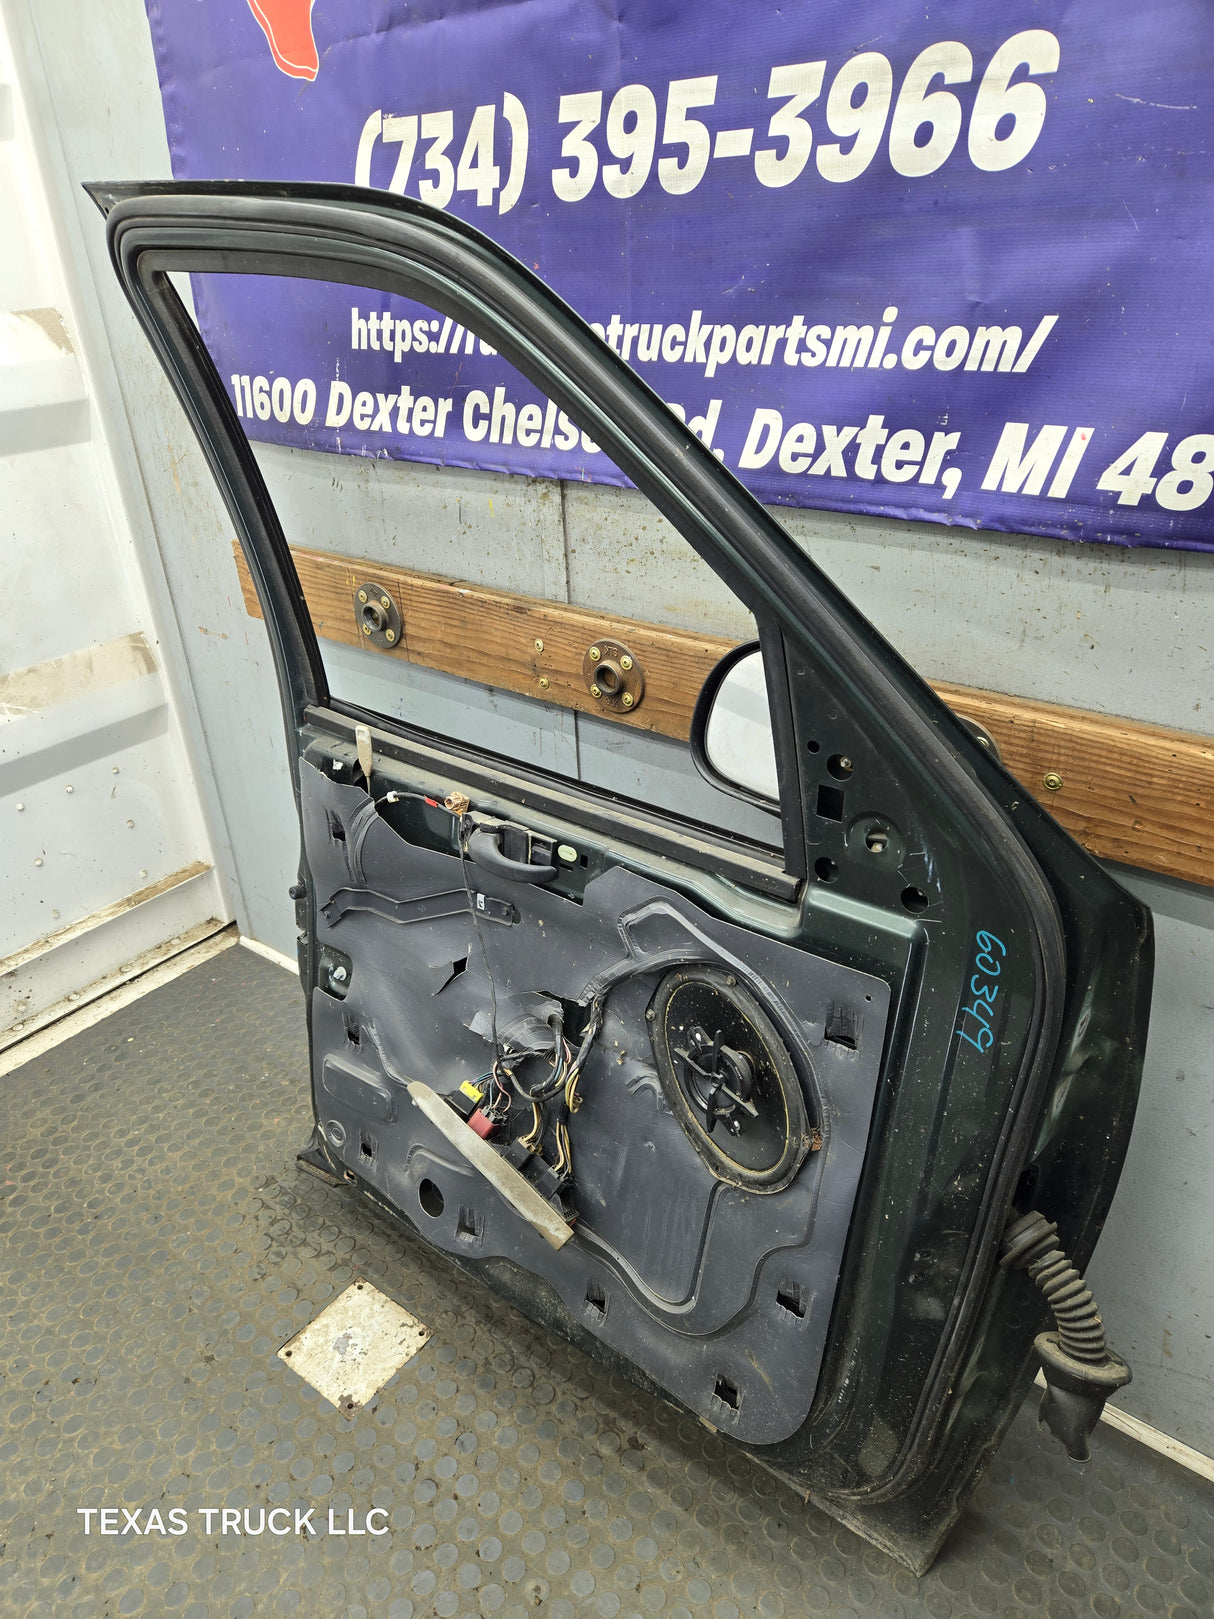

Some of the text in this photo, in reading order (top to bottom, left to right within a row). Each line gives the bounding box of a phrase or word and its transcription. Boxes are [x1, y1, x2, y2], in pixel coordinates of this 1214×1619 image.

[355, 29, 1061, 215] (734) 395-3966
[231, 373, 317, 426] 11600
[325, 380, 453, 438] Dexter
[463, 386, 602, 454] Chels
[738, 407, 962, 499] Dexter,
[980, 422, 1095, 499] MI
[1096, 431, 1214, 512] 48
[956, 930, 1007, 1053] 60349
